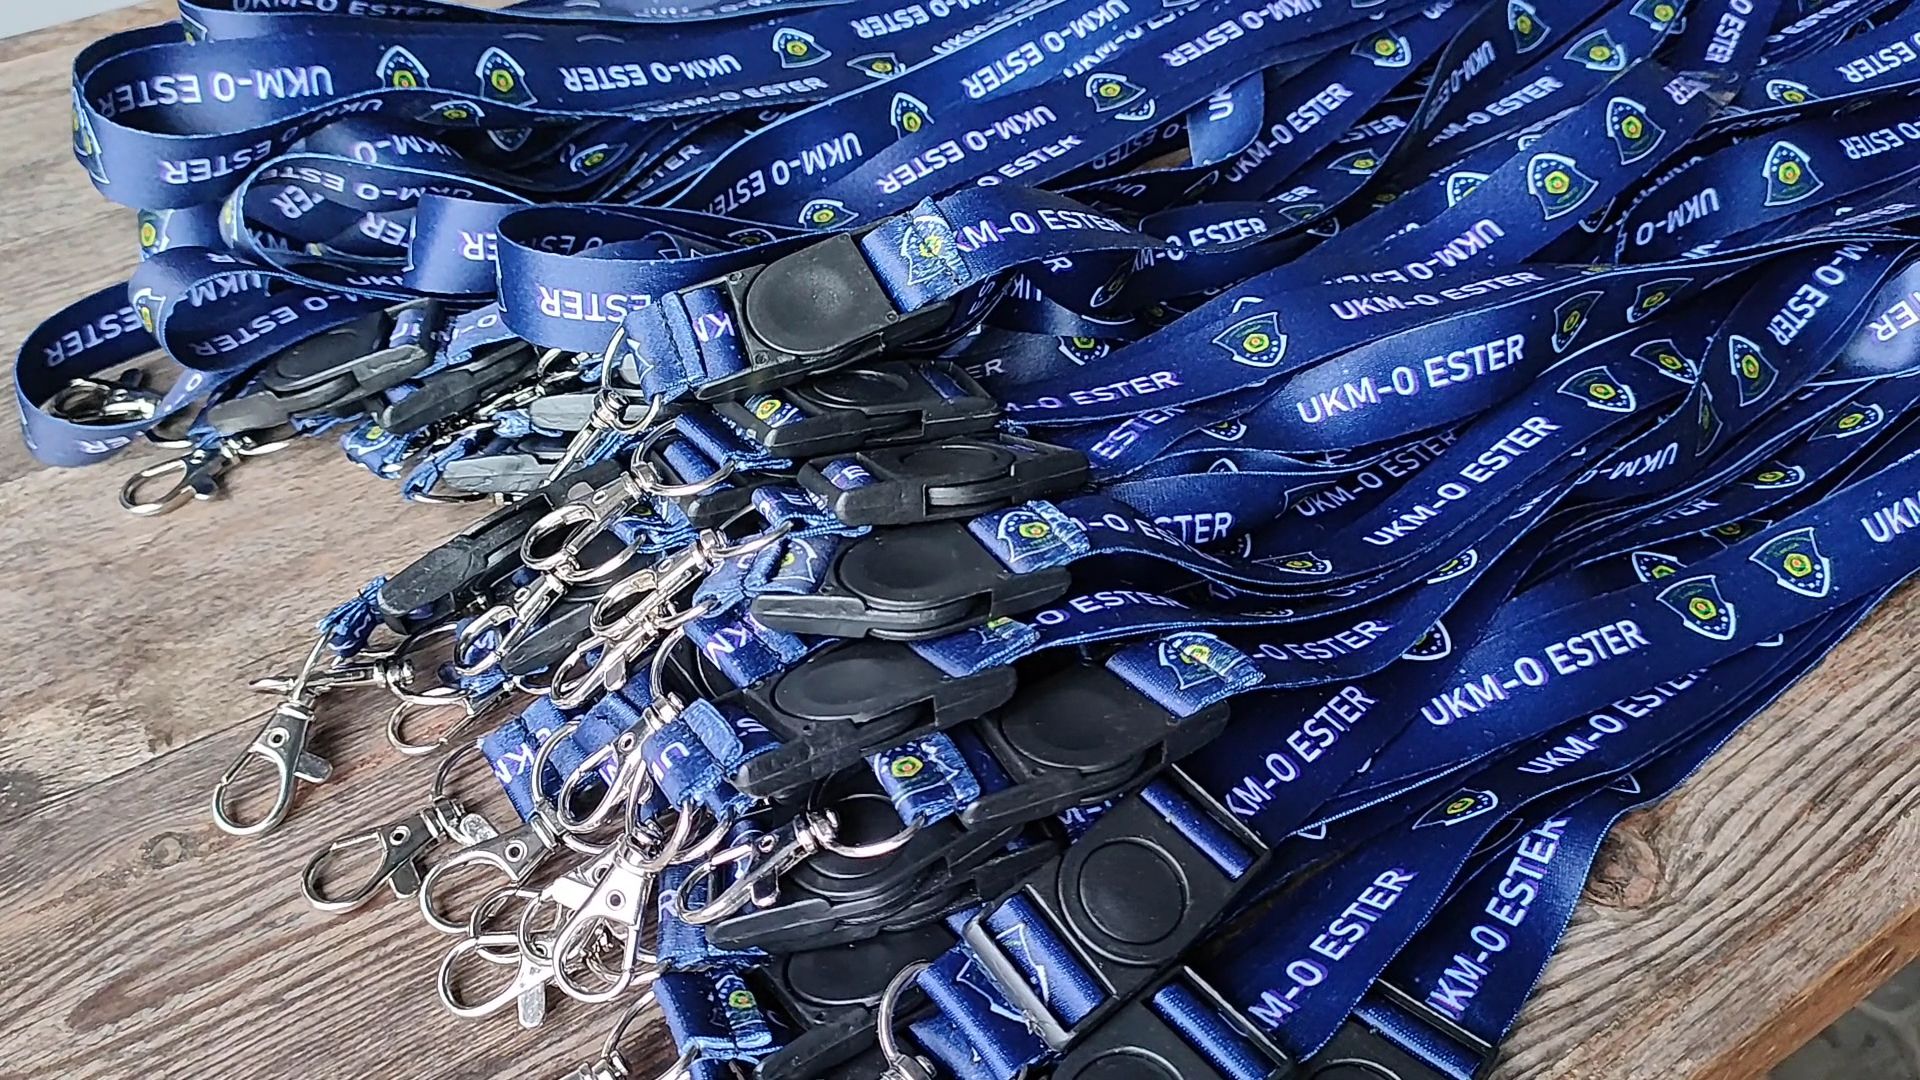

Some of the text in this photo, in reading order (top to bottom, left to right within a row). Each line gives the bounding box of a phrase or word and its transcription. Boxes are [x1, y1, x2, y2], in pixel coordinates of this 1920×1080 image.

[850, 4, 930, 38] ESTER
[1160, 23, 1244, 67] ESTER
[1704, 14, 1747, 63] ESTER
[560, 64, 649, 92] ESTER
[960, 41, 1044, 98] ESTER
[1836, 41, 1917, 83] ESTER
[101, 73, 202, 117] ESTER
[1286, 82, 1353, 134] ESTER
[1486, 76, 1564, 116] ESTER
[1339, 114, 1407, 143] STER
[1840, 128, 1904, 160] ESTER
[160, 139, 271, 184] ESTER
[876, 140, 965, 194] ESTER
[1037, 209, 1131, 234] ESTER
[1440, 271, 1545, 301] ESTER
[44, 305, 143, 367] ESTER
[188, 305, 300, 357] ESTER
[1766, 284, 1829, 346] ESTER
[1423, 334, 1525, 388] ESTER
[1069, 371, 1184, 405] ESTER
[1387, 429, 1457, 477] ESTER
[1460, 416, 1562, 482] ESTER
[1285, 620, 1391, 661] ESTER
[1544, 619, 1650, 675] ESTER
[1286, 685, 1375, 763] ESTER
[1485, 820, 1568, 927] ESTER
[1309, 868, 1417, 961] ESTER
